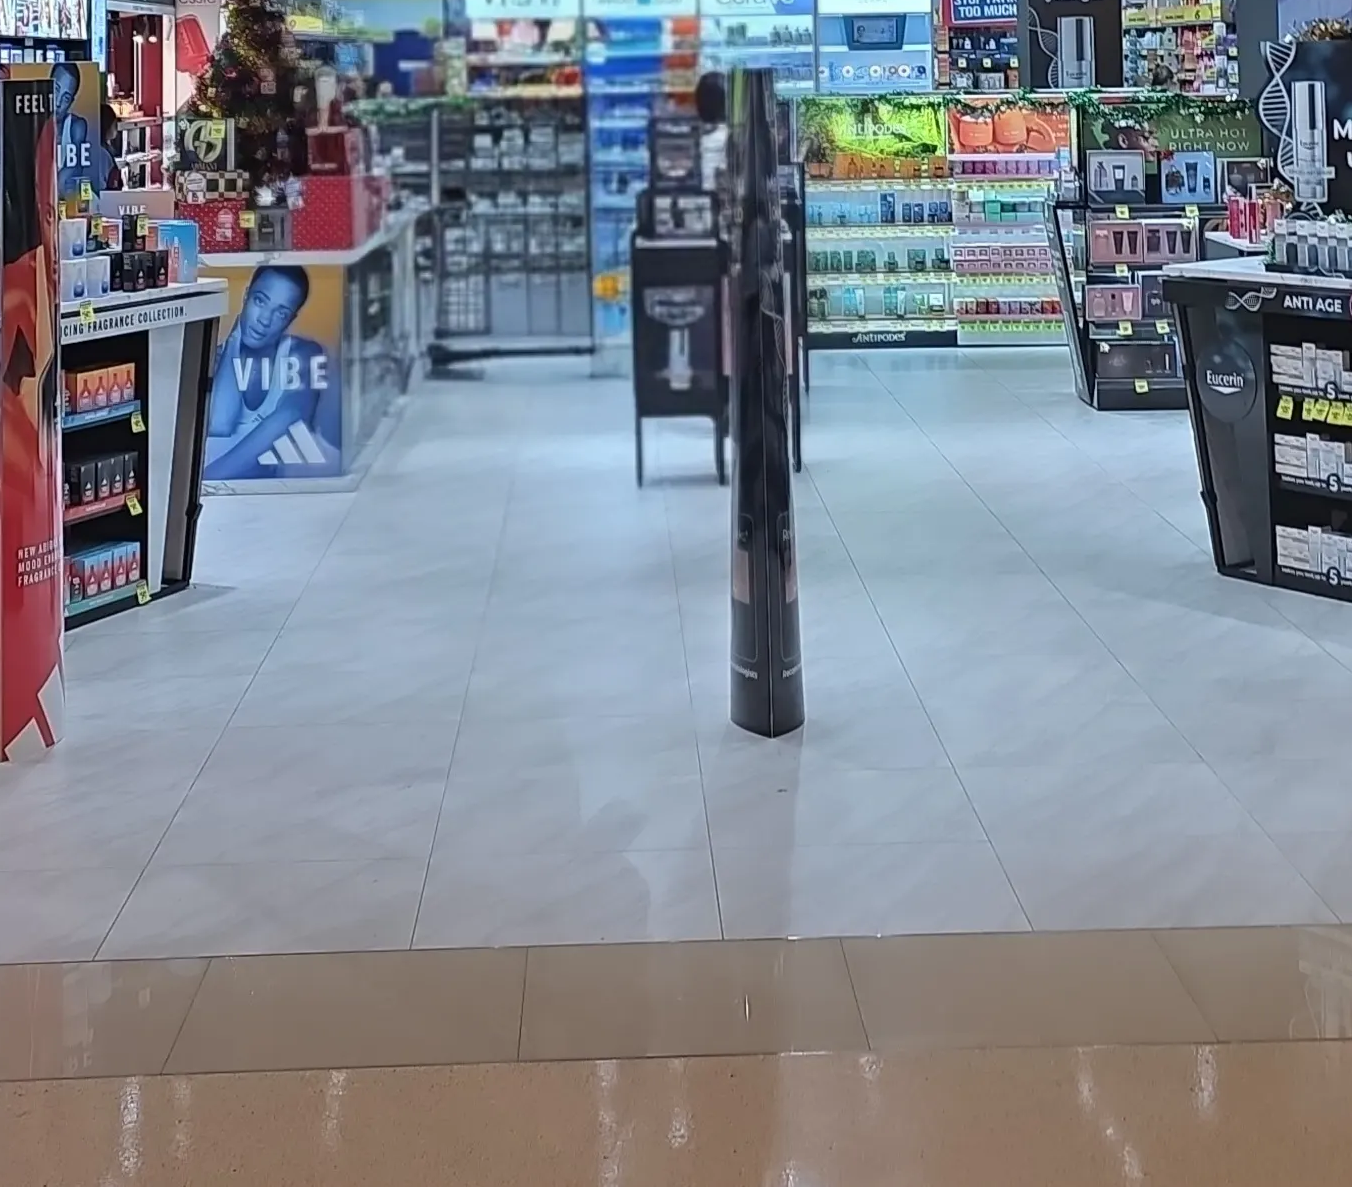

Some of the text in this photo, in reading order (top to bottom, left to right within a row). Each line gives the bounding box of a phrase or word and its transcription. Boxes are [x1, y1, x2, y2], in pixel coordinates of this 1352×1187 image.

[958, 4, 1017, 18] TOO MUCH
[15, 94, 46, 113] FEEL
[1171, 128, 1246, 139] ULTRA HOT
[1169, 141, 1250, 151] RIGHT NOW
[56, 143, 91, 170] IBE
[118, 204, 147, 216] VIBE
[1283, 294, 1342, 313] ANTI AGE
[88, 306, 187, 334] FRAGRANCE COLLECTION.
[232, 355, 328, 392] VIBE
[1206, 370, 1244, 388] Eucerin
[1327, 383, 1336, 399] 5
[1329, 475, 1338, 493] 5
[18, 546, 37, 560] NEW
[18, 557, 42, 574] MOOD
[1329, 568, 1338, 585] 5
